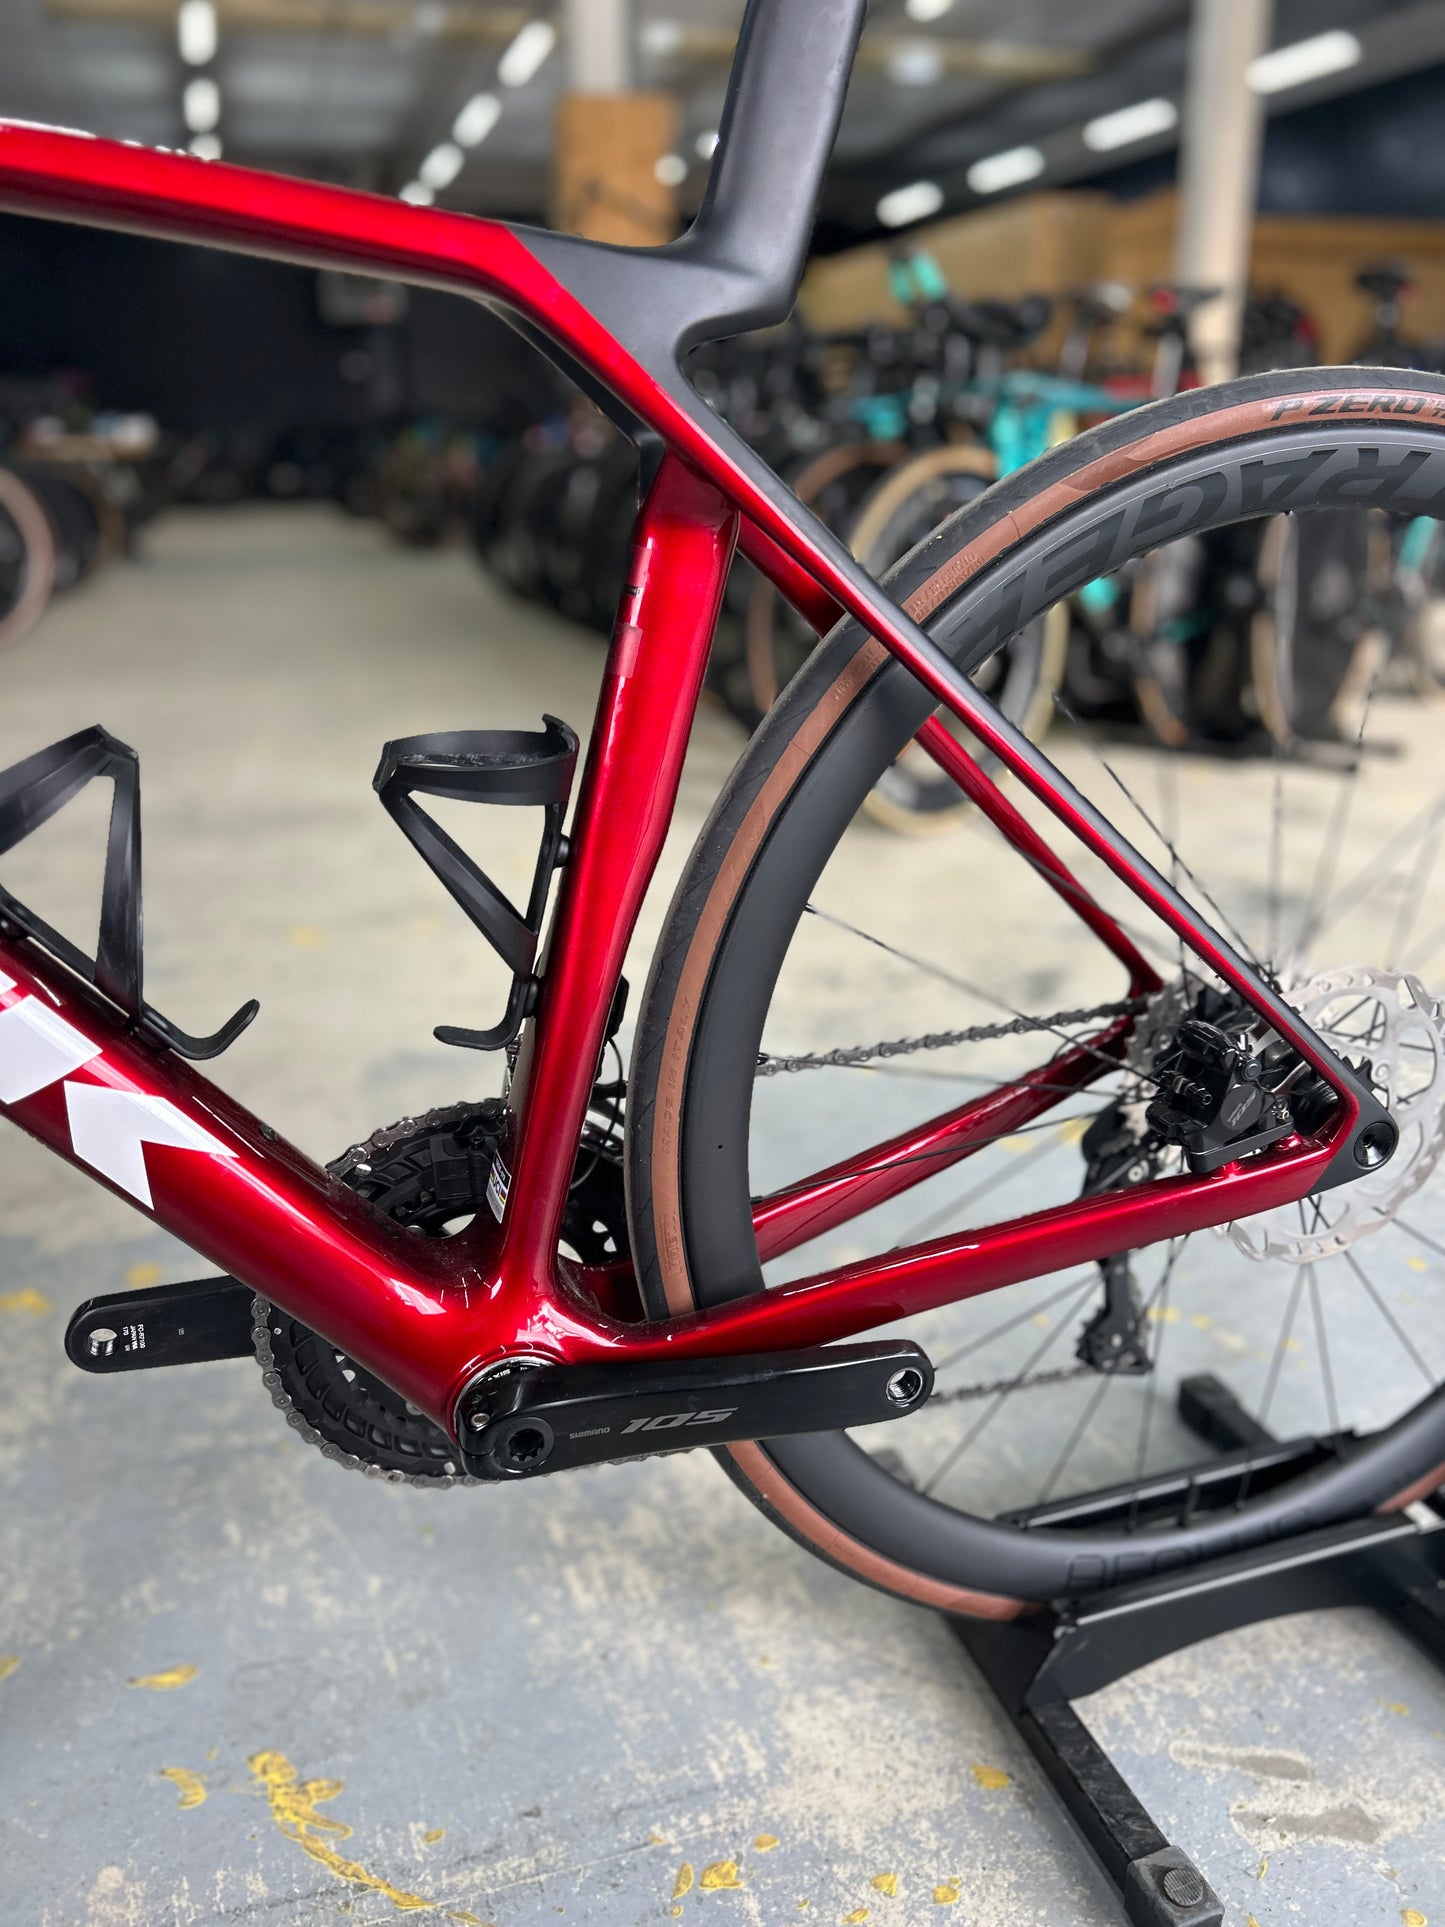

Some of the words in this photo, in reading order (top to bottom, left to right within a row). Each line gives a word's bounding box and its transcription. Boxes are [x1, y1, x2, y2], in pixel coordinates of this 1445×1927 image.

[1270, 399, 1304, 421] P
[1307, 394, 1427, 416] ZERO
[671, 995, 694, 1063] ITALY
[667, 1067, 680, 1090] IN
[569, 1426, 611, 1440] SHIMANO
[620, 1406, 740, 1435] 105
